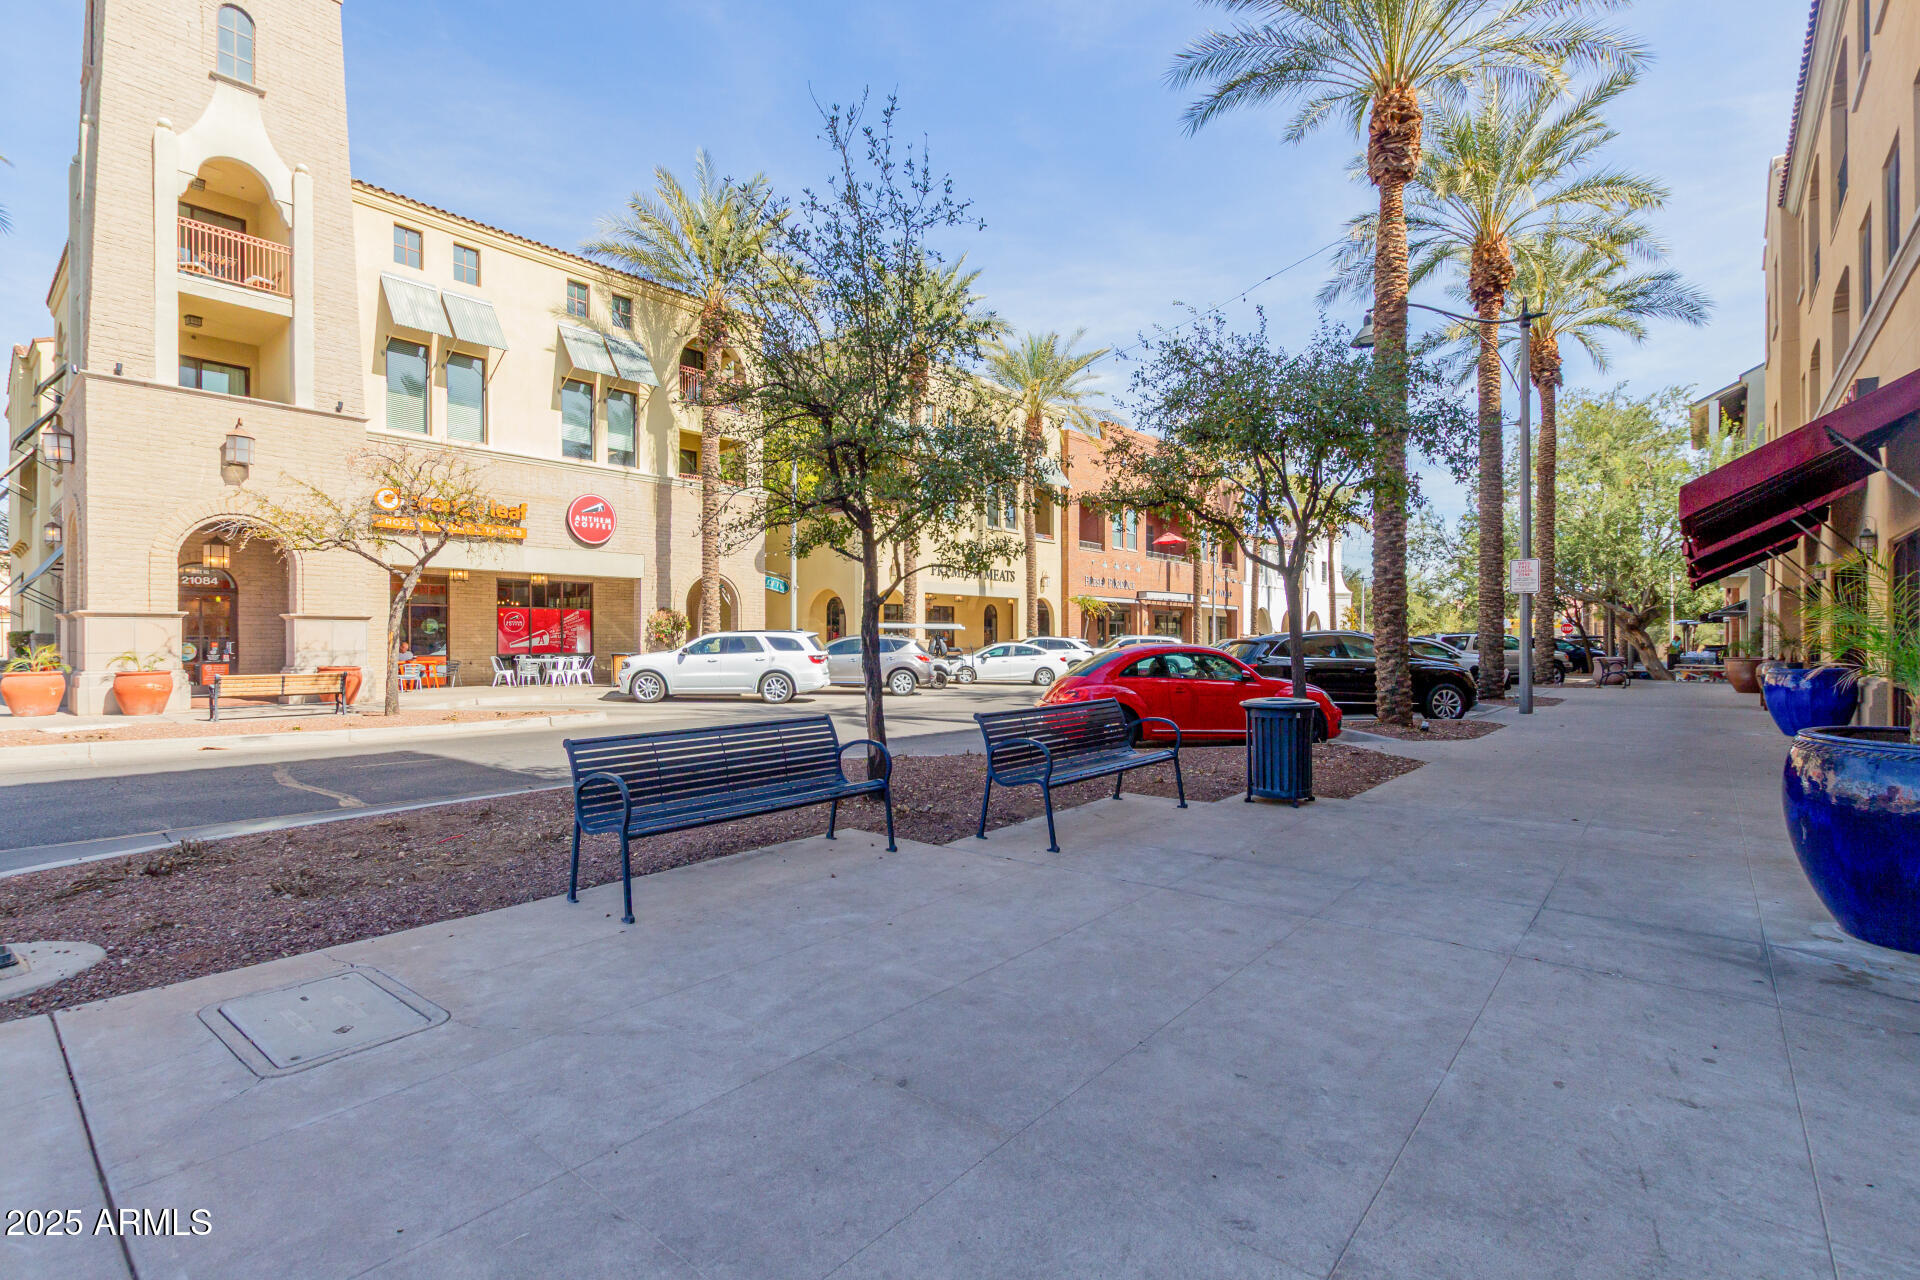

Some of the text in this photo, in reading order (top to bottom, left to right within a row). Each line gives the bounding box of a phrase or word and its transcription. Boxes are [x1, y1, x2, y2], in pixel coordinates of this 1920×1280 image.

[488, 499, 528, 520] leaf
[575, 515, 611, 524] ANTHEM
[575, 521, 612, 530] COFFEE
[984, 568, 1016, 582] MEATS
[181, 576, 218, 585] 21084
